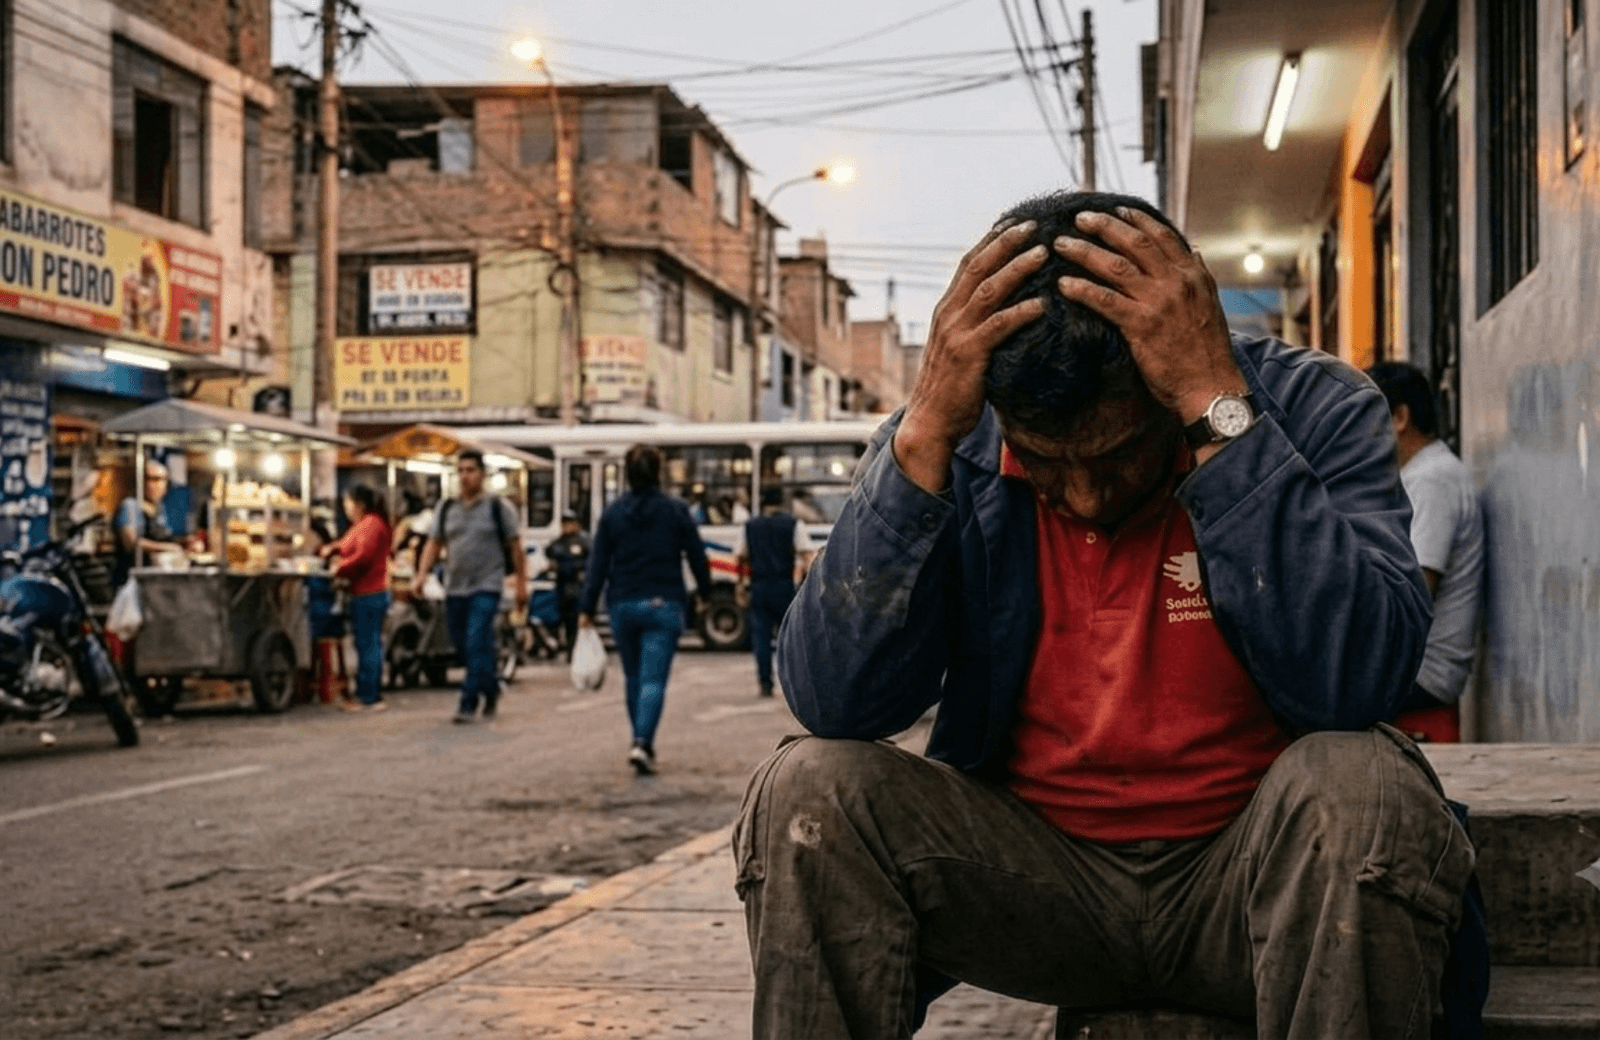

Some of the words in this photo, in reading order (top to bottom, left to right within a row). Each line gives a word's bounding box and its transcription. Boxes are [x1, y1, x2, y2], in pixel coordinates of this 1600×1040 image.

[0, 195, 106, 257] ABARROTES
[42, 251, 115, 307] PEDRO
[376, 269, 397, 291] SE
[403, 267, 464, 290] VENDE
[342, 341, 372, 366] SE
[380, 340, 463, 364] VENDE
